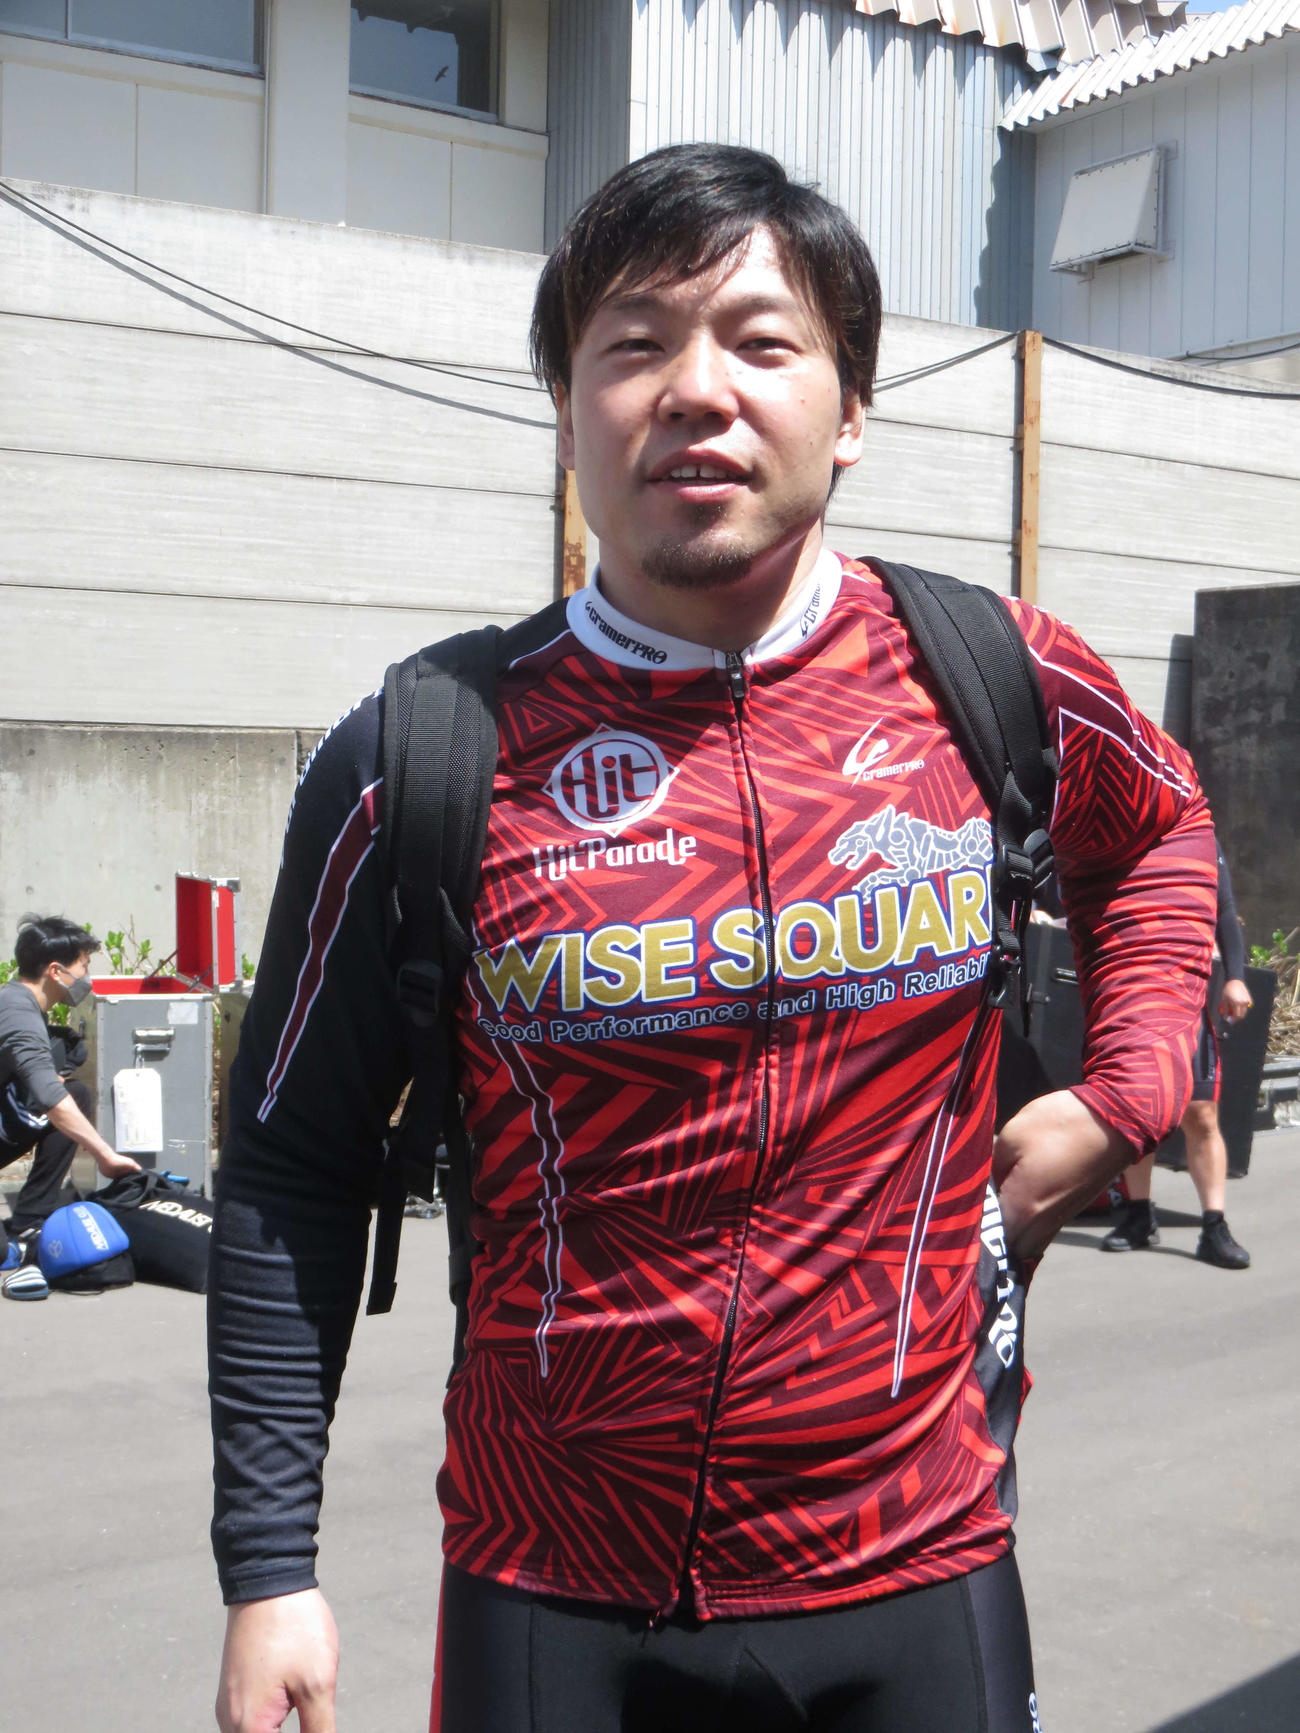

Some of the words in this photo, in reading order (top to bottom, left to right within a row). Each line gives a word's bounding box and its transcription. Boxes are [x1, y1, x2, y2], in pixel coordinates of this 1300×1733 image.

[473, 917, 697, 1014] WISE
[708, 864, 994, 990] SQUAR
[477, 1018, 543, 1042] Good
[549, 1002, 750, 1043] Performance
[757, 989, 816, 1020] and
[825, 978, 896, 1010] High
[903, 951, 989, 998] Reliabi
